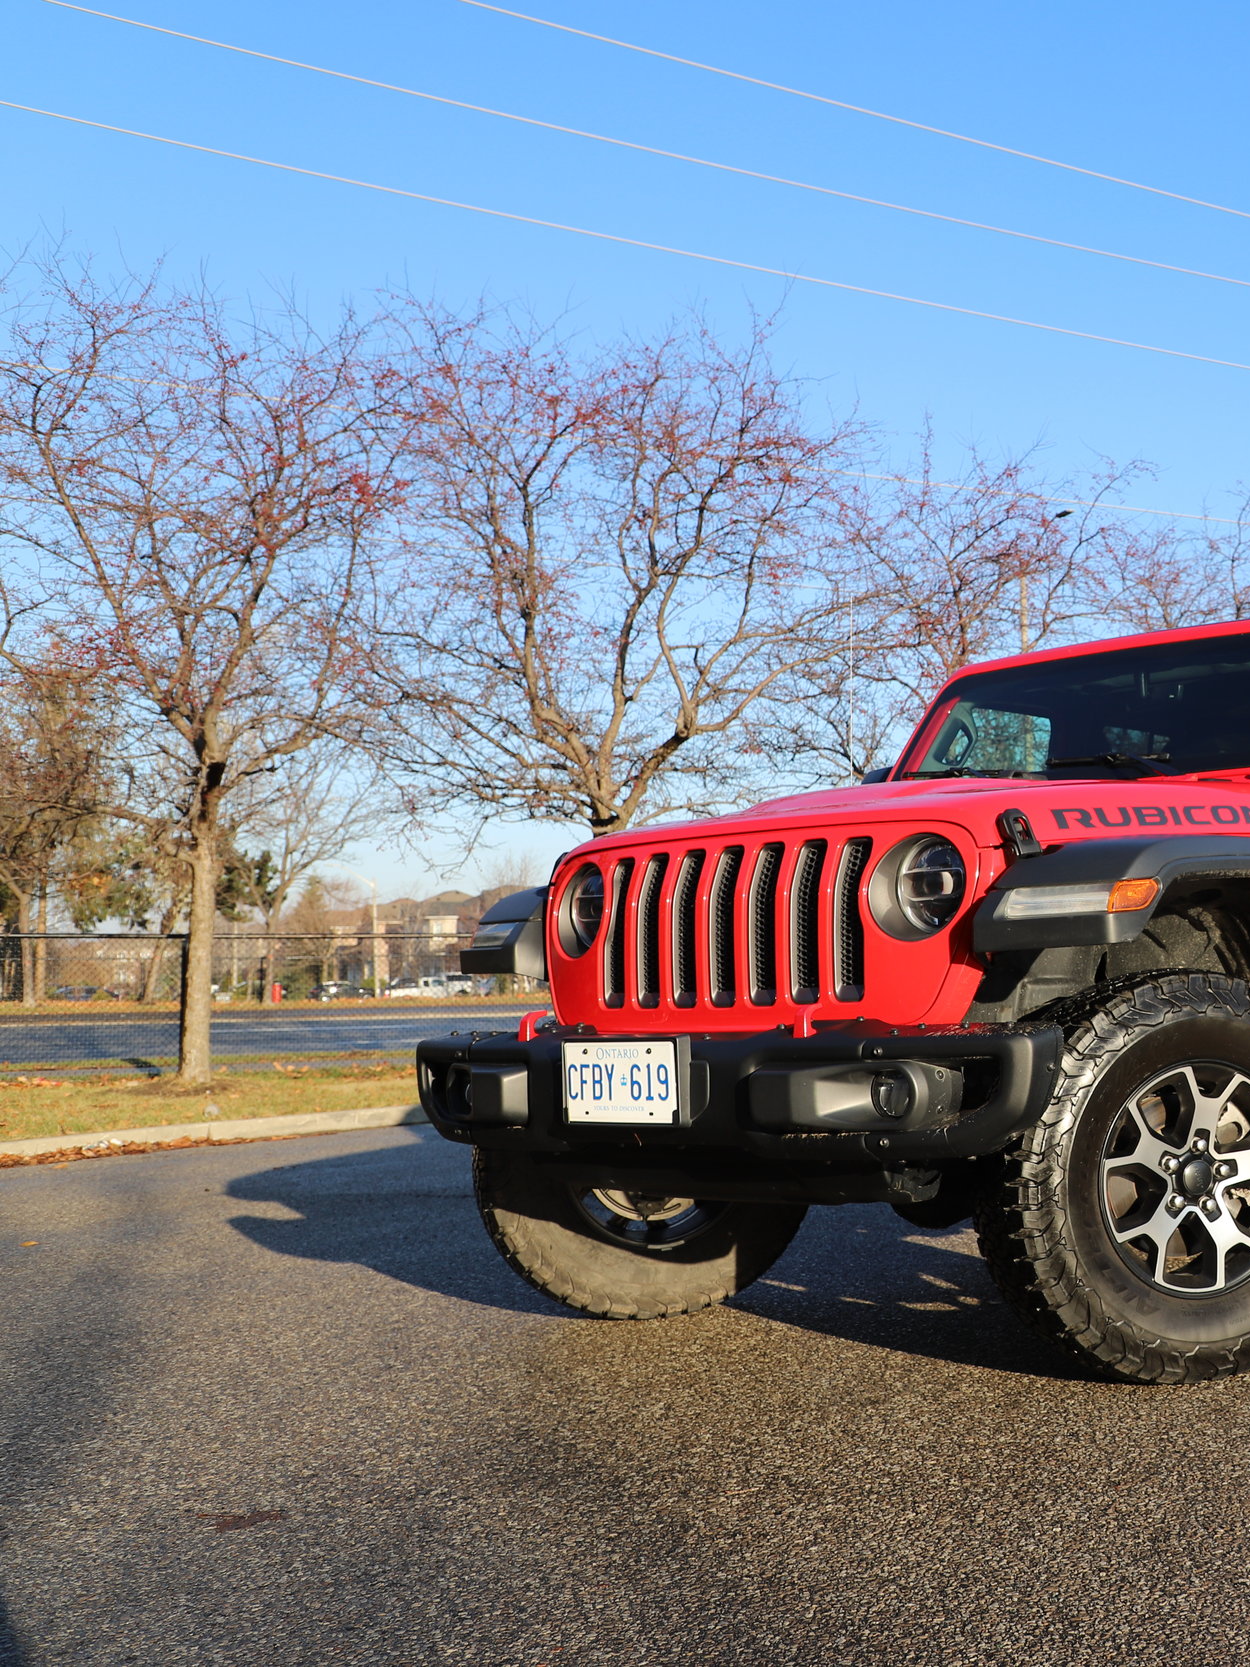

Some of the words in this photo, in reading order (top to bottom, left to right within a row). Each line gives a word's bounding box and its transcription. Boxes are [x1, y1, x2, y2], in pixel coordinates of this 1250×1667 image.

[595, 1047, 639, 1060] ONTARIO
[567, 1063, 615, 1101] CFBY
[630, 1063, 669, 1101] 619
